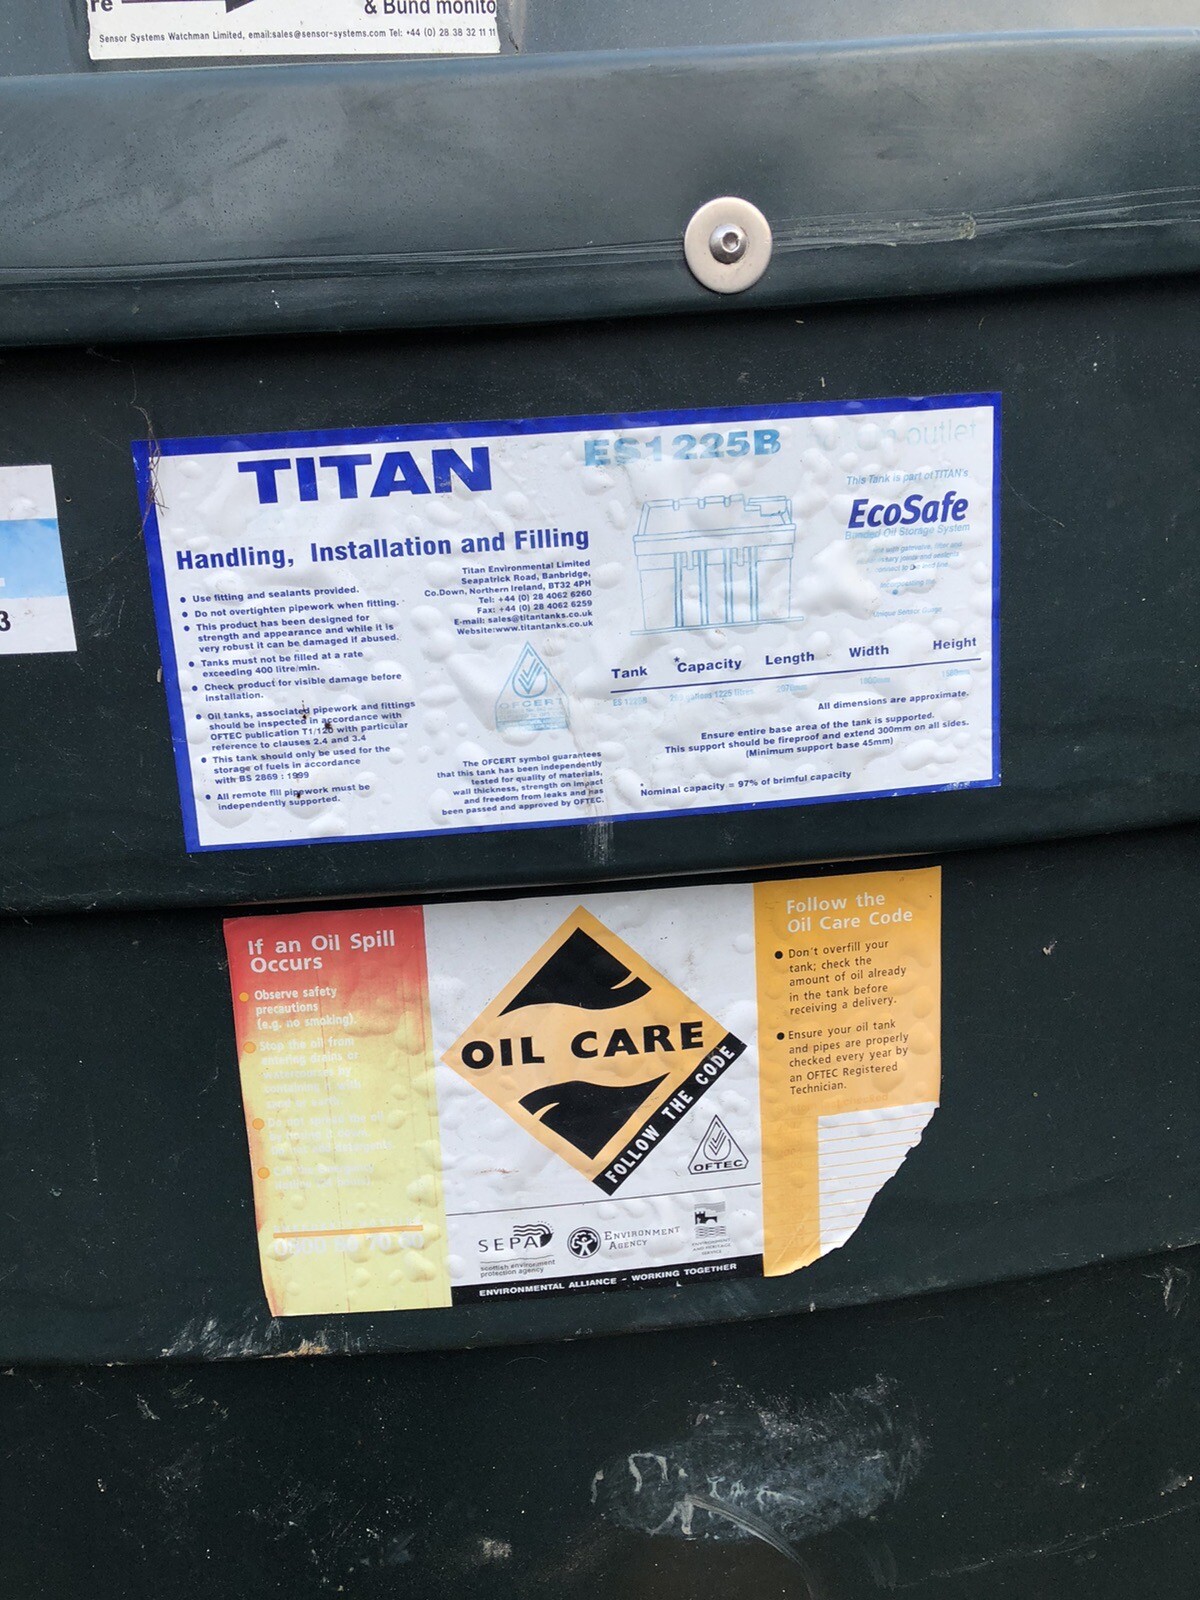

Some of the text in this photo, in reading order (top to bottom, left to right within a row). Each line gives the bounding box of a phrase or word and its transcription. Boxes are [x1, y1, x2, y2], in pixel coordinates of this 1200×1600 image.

[364, 0, 377, 14] &
[383, 0, 430, 14] Bund
[99, 34, 127, 43] Sensor
[130, 33, 165, 43] Systems
[167, 31, 209, 40] Watchman
[212, 31, 245, 39] Limited,
[248, 29, 386, 39] email:sales@sensor-systems.com
[389, 28, 402, 37] Tel:
[424, 28, 435, 37] (0)
[439, 28, 449, 36] 28
[452, 28, 463, 36] 38
[466, 28, 475, 36] 32
[479, 28, 485, 36] 11
[489, 28, 496, 37] 11
[585, 429, 781, 467] ES1225B
[237, 446, 492, 504] TITAN
[848, 491, 968, 528] EcoSafe
[883, 526, 896, 538] Oil
[899, 525, 935, 537] Storage
[937, 522, 971, 535] System
[176, 528, 588, 570] Handling, Installation and Filling
[488, 562, 553, 572] Environmental
[556, 560, 590, 568] Limited
[461, 571, 590, 585] Seapatrick Road, Banbridge,
[511, 583, 545, 591] Ireland,
[548, 581, 570, 589] BT32
[573, 579, 591, 587] 4PH
[214, 593, 243, 602] fitting
[247, 591, 265, 599] and
[268, 589, 311, 598] sealants
[314, 586, 359, 597] provided.
[518, 594, 529, 602] (0)
[546, 591, 567, 599] 4062
[570, 589, 592, 597] 6260
[229, 606, 285, 616] overtighten
[288, 602, 334, 613] pipework
[196, 623, 217, 631] This
[220, 621, 257, 631] product
[308, 615, 353, 624] designed
[454, 610, 592, 625] E-mail: sales@titantanks.co.uk
[457, 620, 593, 634] Website:www.titantanks.co.uk
[849, 645, 889, 657] Width
[933, 637, 976, 650] Height
[232, 657, 257, 665] must
[260, 655, 276, 663] not
[294, 652, 318, 661] filled
[765, 651, 814, 665] Length
[202, 668, 252, 677] exceeding
[276, 664, 319, 672] litre/min.
[611, 666, 647, 678] Tank
[677, 658, 742, 674] Capacity
[818, 702, 830, 710] All
[833, 698, 887, 709] dimensions
[909, 690, 968, 703] approximate.
[746, 747, 793, 758] (Minimum
[796, 742, 833, 753] support
[862, 737, 893, 746] 45mm)
[481, 757, 516, 765] OFCERT
[519, 754, 549, 764] symbol
[552, 752, 601, 761] guarantees
[641, 786, 680, 796] Nominal
[683, 782, 725, 793] capacity
[738, 779, 758, 787] 97%
[761, 777, 770, 785] of
[773, 774, 807, 784] brimful
[810, 771, 851, 781] capacity
[787, 892, 885, 914] Follow the
[787, 908, 912, 932] Oil Care Code
[248, 930, 394, 958] If an Oil Spill
[823, 941, 860, 954] overfill
[865, 941, 888, 952] your
[250, 957, 322, 973] Occurs
[789, 956, 871, 972] tank; check the
[254, 986, 337, 1000] Observe safety
[256, 1001, 318, 1017] precautions
[256, 1012, 357, 1031] (e.g. no smoking).
[461, 1021, 703, 1069] OIL CARE
[790, 1081, 846, 1094] Technician.
[604, 1045, 736, 1184] FOLLOW THE CODE
[693, 1159, 743, 1172] OFTEC
[604, 1226, 681, 1241] ENVIRONMENT
[478, 1234, 541, 1253] SEPA
[608, 1239, 647, 1250] AGENCY
[510, 1259, 555, 1268] environment
[479, 1283, 565, 1296] ENVIRONMENTAL
[568, 1277, 616, 1288] ALLIANCE
[631, 1270, 679, 1281] WORKING
[683, 1263, 736, 1275] TOGETHER
[480, 1267, 544, 1278] protection agency
